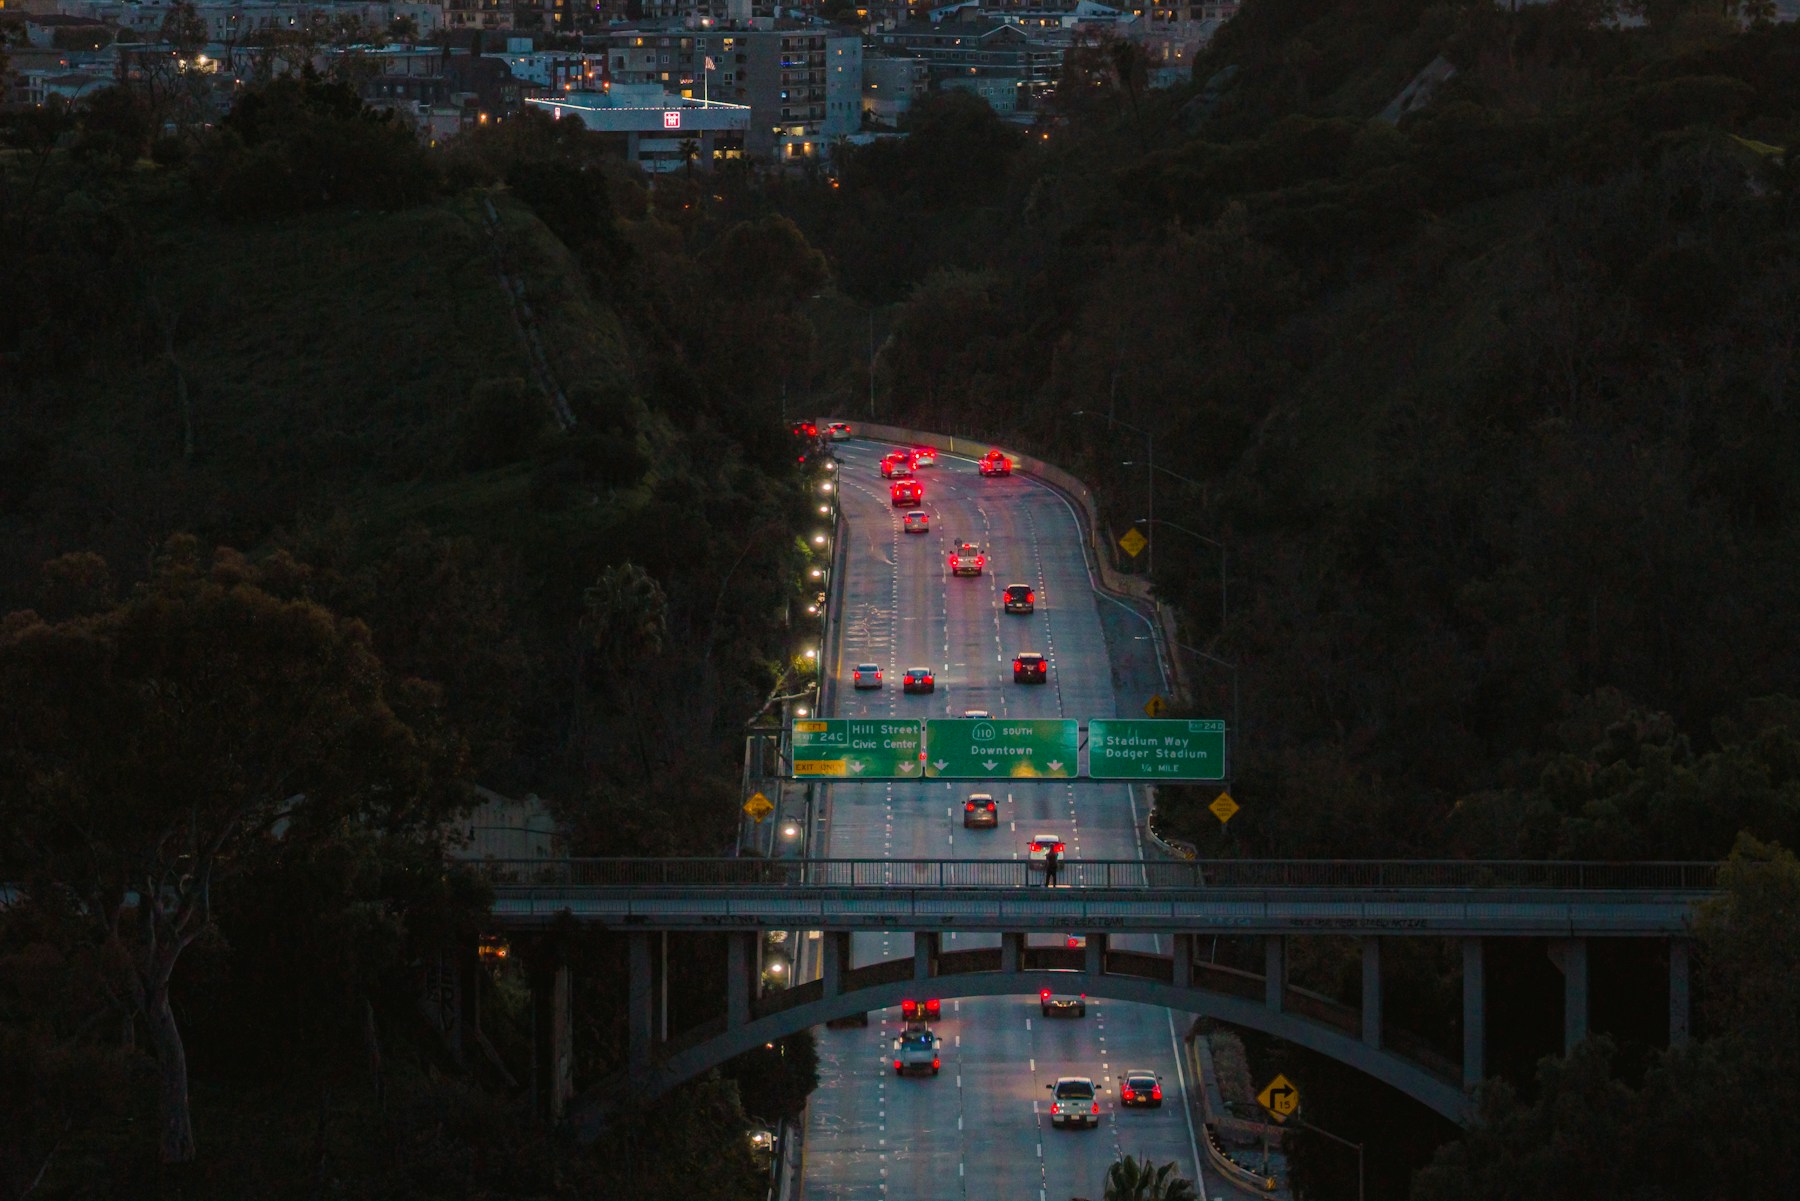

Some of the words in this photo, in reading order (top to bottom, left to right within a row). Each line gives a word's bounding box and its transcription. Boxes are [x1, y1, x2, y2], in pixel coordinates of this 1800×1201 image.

[802, 723, 821, 731] EFT
[852, 724, 874, 734] Hill
[880, 724, 919, 734] Street
[820, 731, 843, 742] 24C
[976, 729, 992, 738] 110
[1003, 727, 1033, 736] SOUTH
[852, 738, 877, 749] Civic
[883, 738, 917, 749] Center
[1106, 735, 1158, 746] Stadium
[1164, 736, 1189, 748] Way
[971, 745, 1033, 755] Downtown
[1106, 748, 1149, 760] Dodger
[1155, 748, 1208, 759] Stadium
[795, 763, 815, 772] EXIT
[1158, 764, 1179, 772] MILE
[1279, 1101, 1291, 1110] 15
